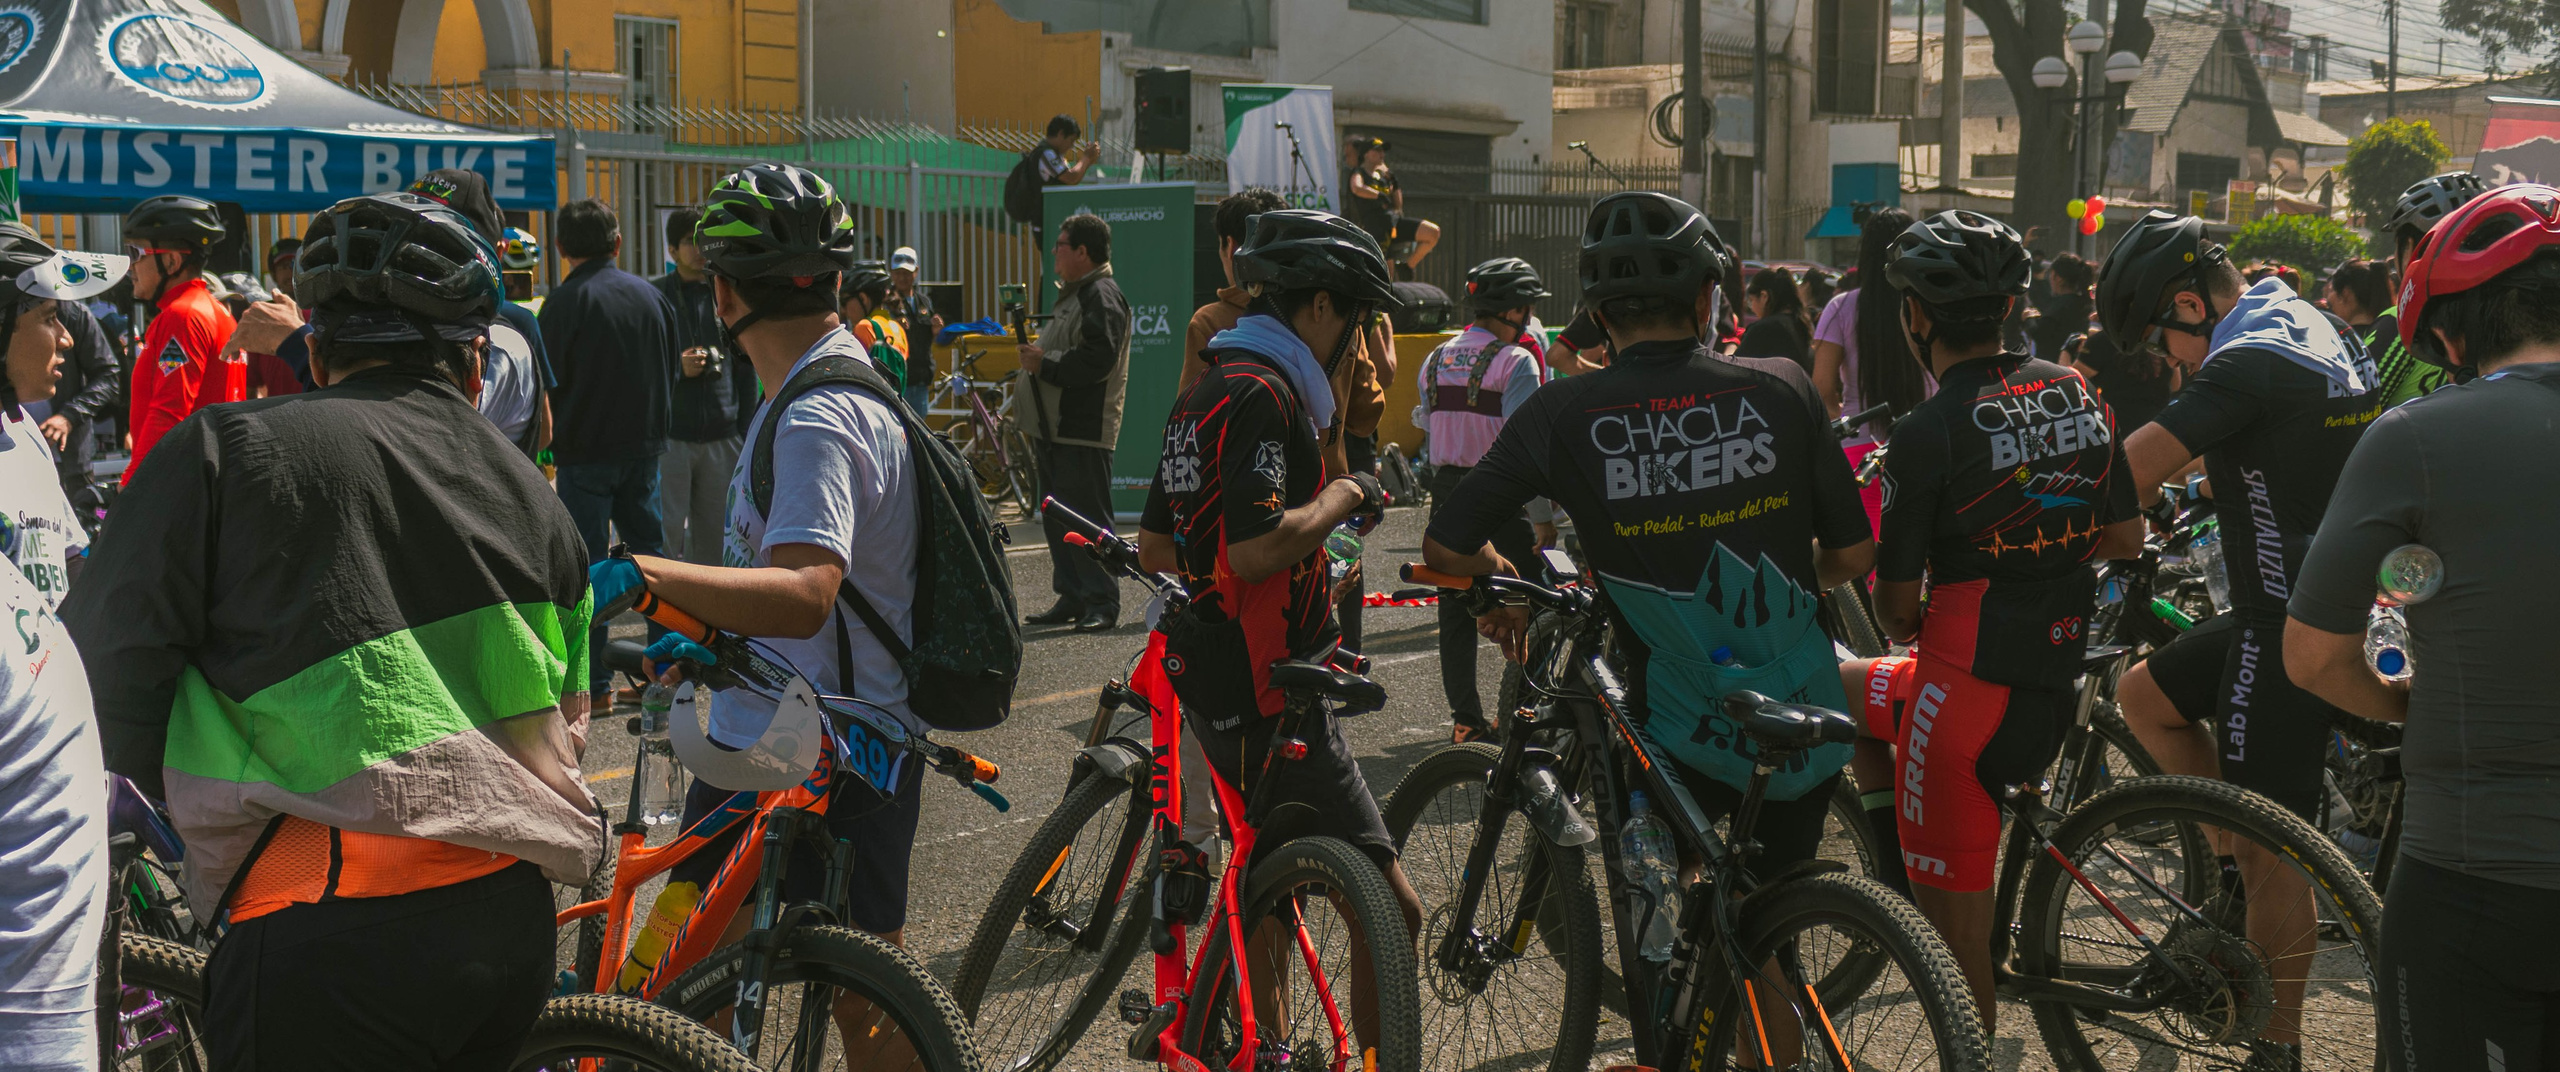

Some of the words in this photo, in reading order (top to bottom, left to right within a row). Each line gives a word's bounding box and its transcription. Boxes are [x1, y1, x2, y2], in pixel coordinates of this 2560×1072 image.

[19, 125, 329, 193] MISTER
[1649, 394, 1696, 412] TEAM
[1972, 381, 2098, 432] CHACLA
[2010, 380, 2046, 396] TEAM
[1590, 397, 1769, 455] CHACLA
[1990, 411, 2111, 471] BIKERS
[1605, 433, 1777, 499] BIKERS
[1614, 521, 1641, 537] Puro
[1644, 515, 1684, 535] Pedal
[1699, 510, 1735, 527] Rutas
[1764, 491, 1789, 513] Perú
[2240, 466, 2290, 601] SPECIALIZED
[2231, 645, 2261, 707] Mont
[848, 723, 889, 791] 69
[1903, 683, 1947, 827] SRAM
[2227, 714, 2248, 762] Lab
[2053, 757, 2077, 811] BLAZE
[680, 963, 730, 1005] ARDENT
[2397, 964, 2418, 1072] ROCKBROS
